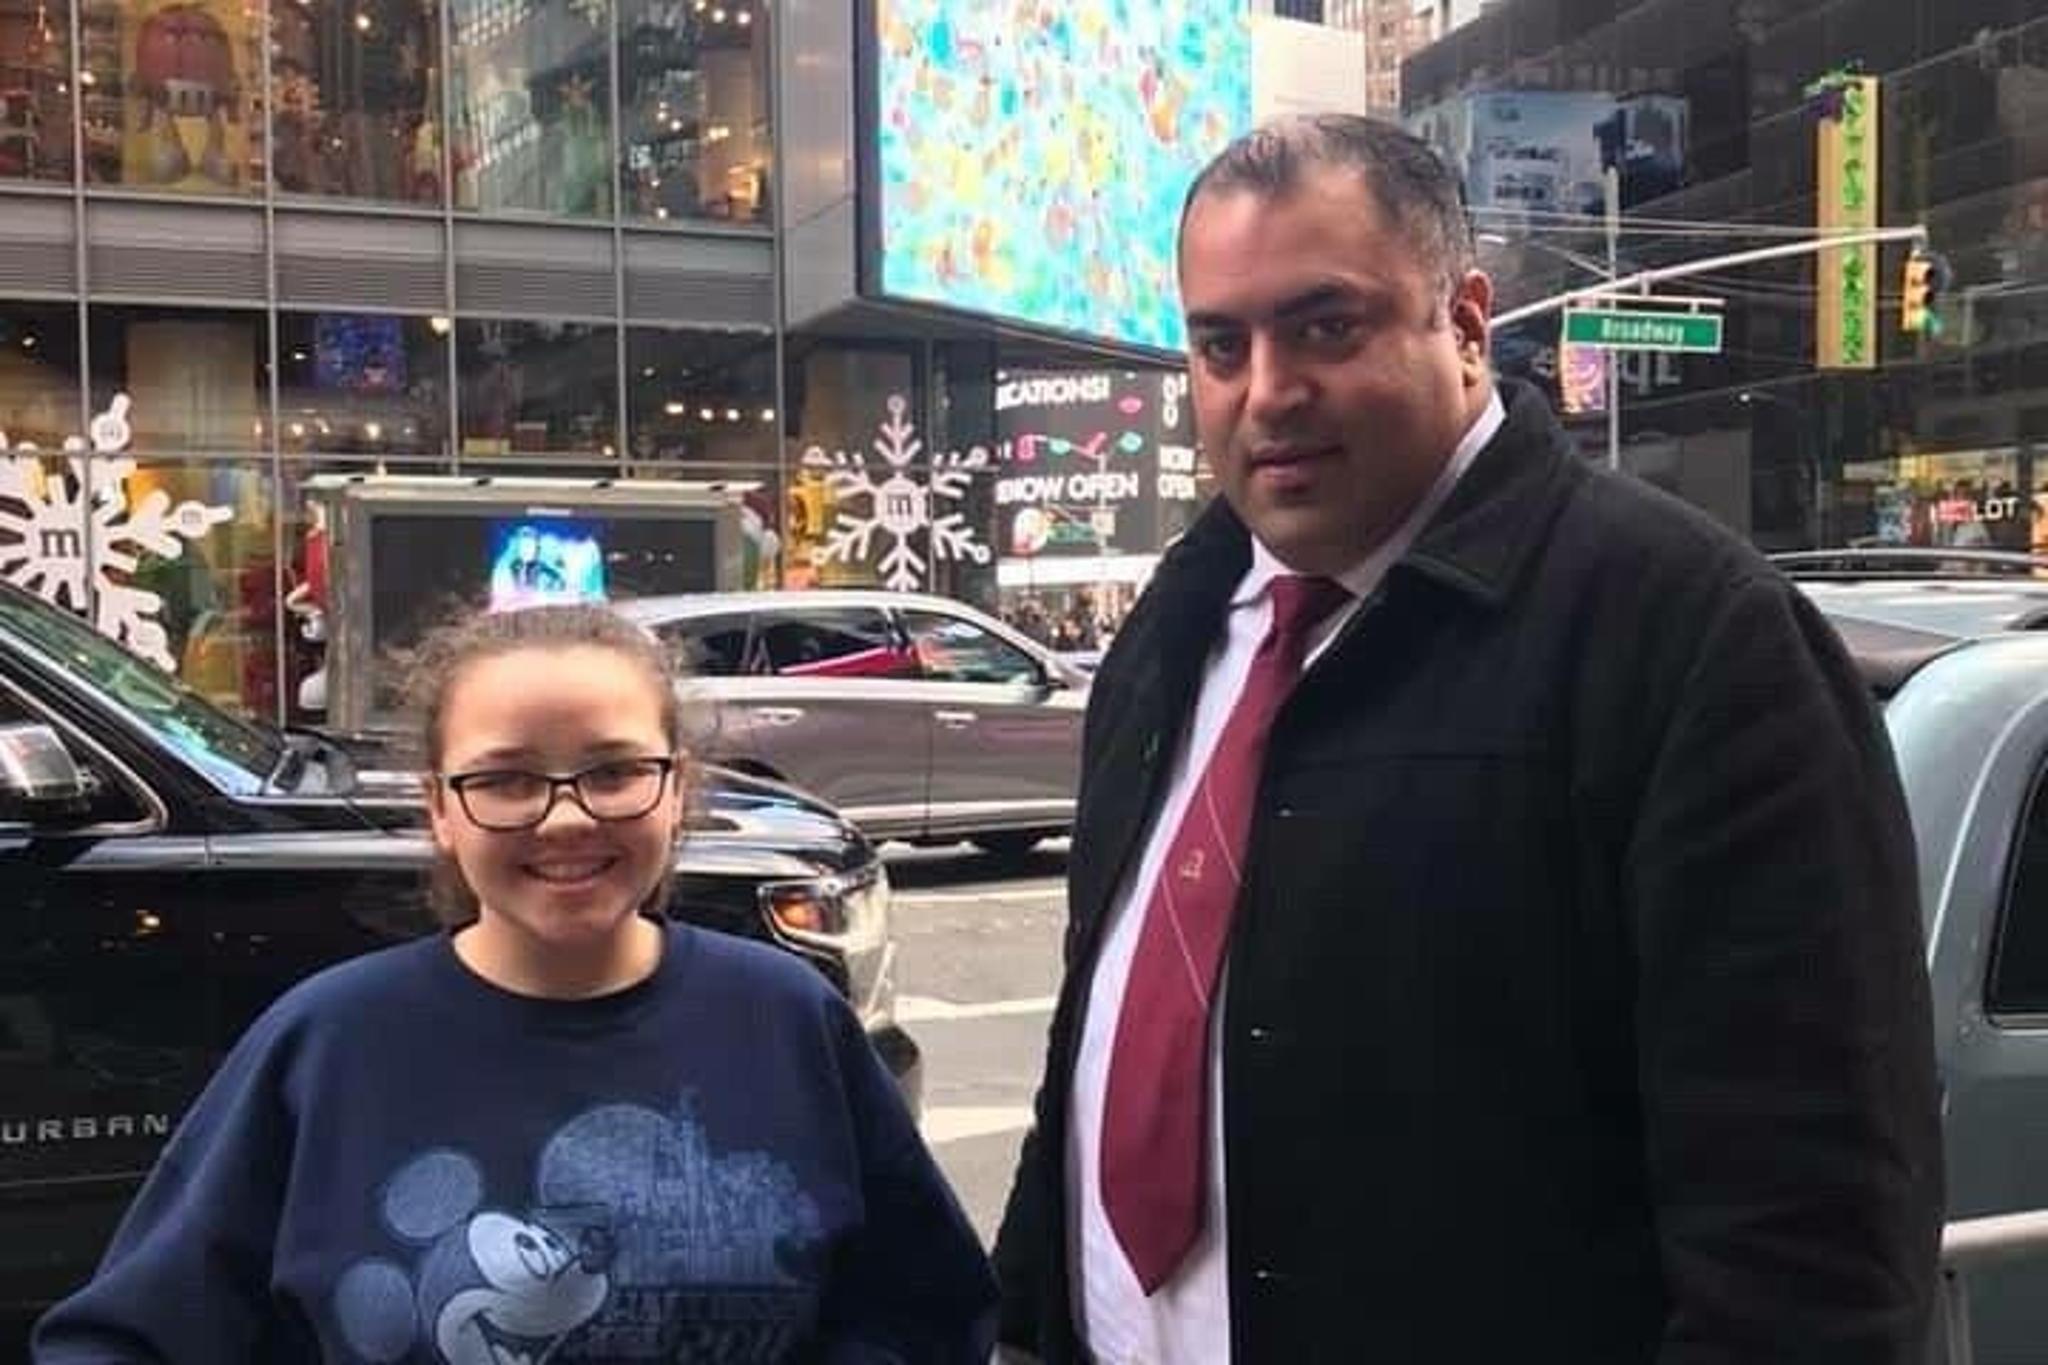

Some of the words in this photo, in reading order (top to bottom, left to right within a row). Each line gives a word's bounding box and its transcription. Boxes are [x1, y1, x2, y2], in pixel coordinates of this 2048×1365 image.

[1601, 317, 1685, 345] Broadway
[1068, 473, 1139, 500] OPEN
[40, 529, 81, 557] m
[1, 1113, 170, 1143] URBAN
